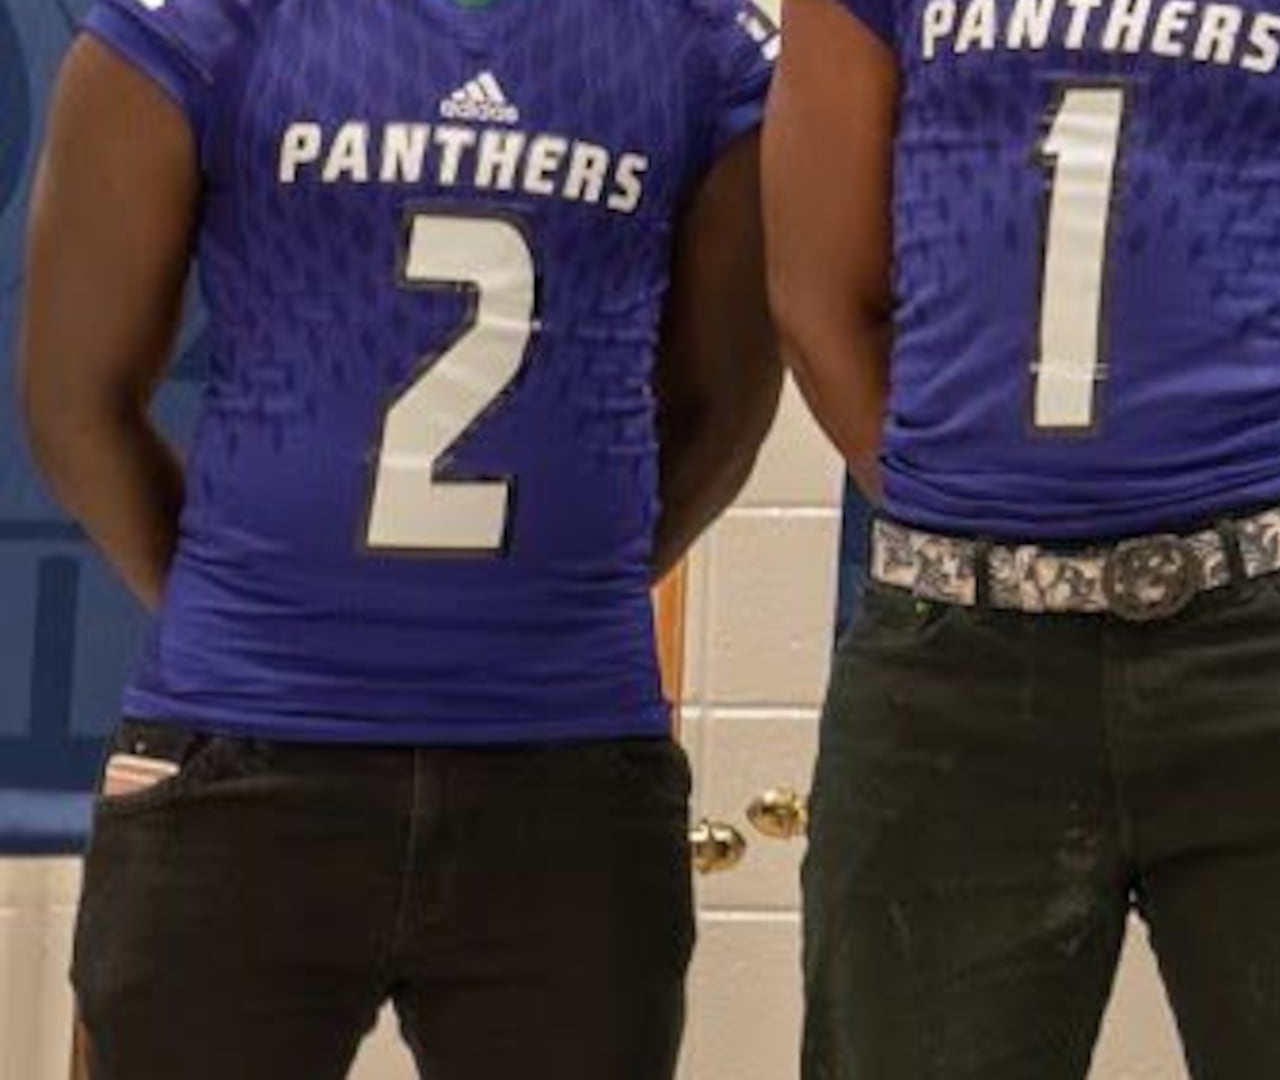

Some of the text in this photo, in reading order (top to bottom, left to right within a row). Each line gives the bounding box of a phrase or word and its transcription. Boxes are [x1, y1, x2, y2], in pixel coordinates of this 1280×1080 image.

[278, 121, 649, 213] PANTHERS
[1034, 87, 1124, 427] 1
[364, 212, 538, 549] 2
